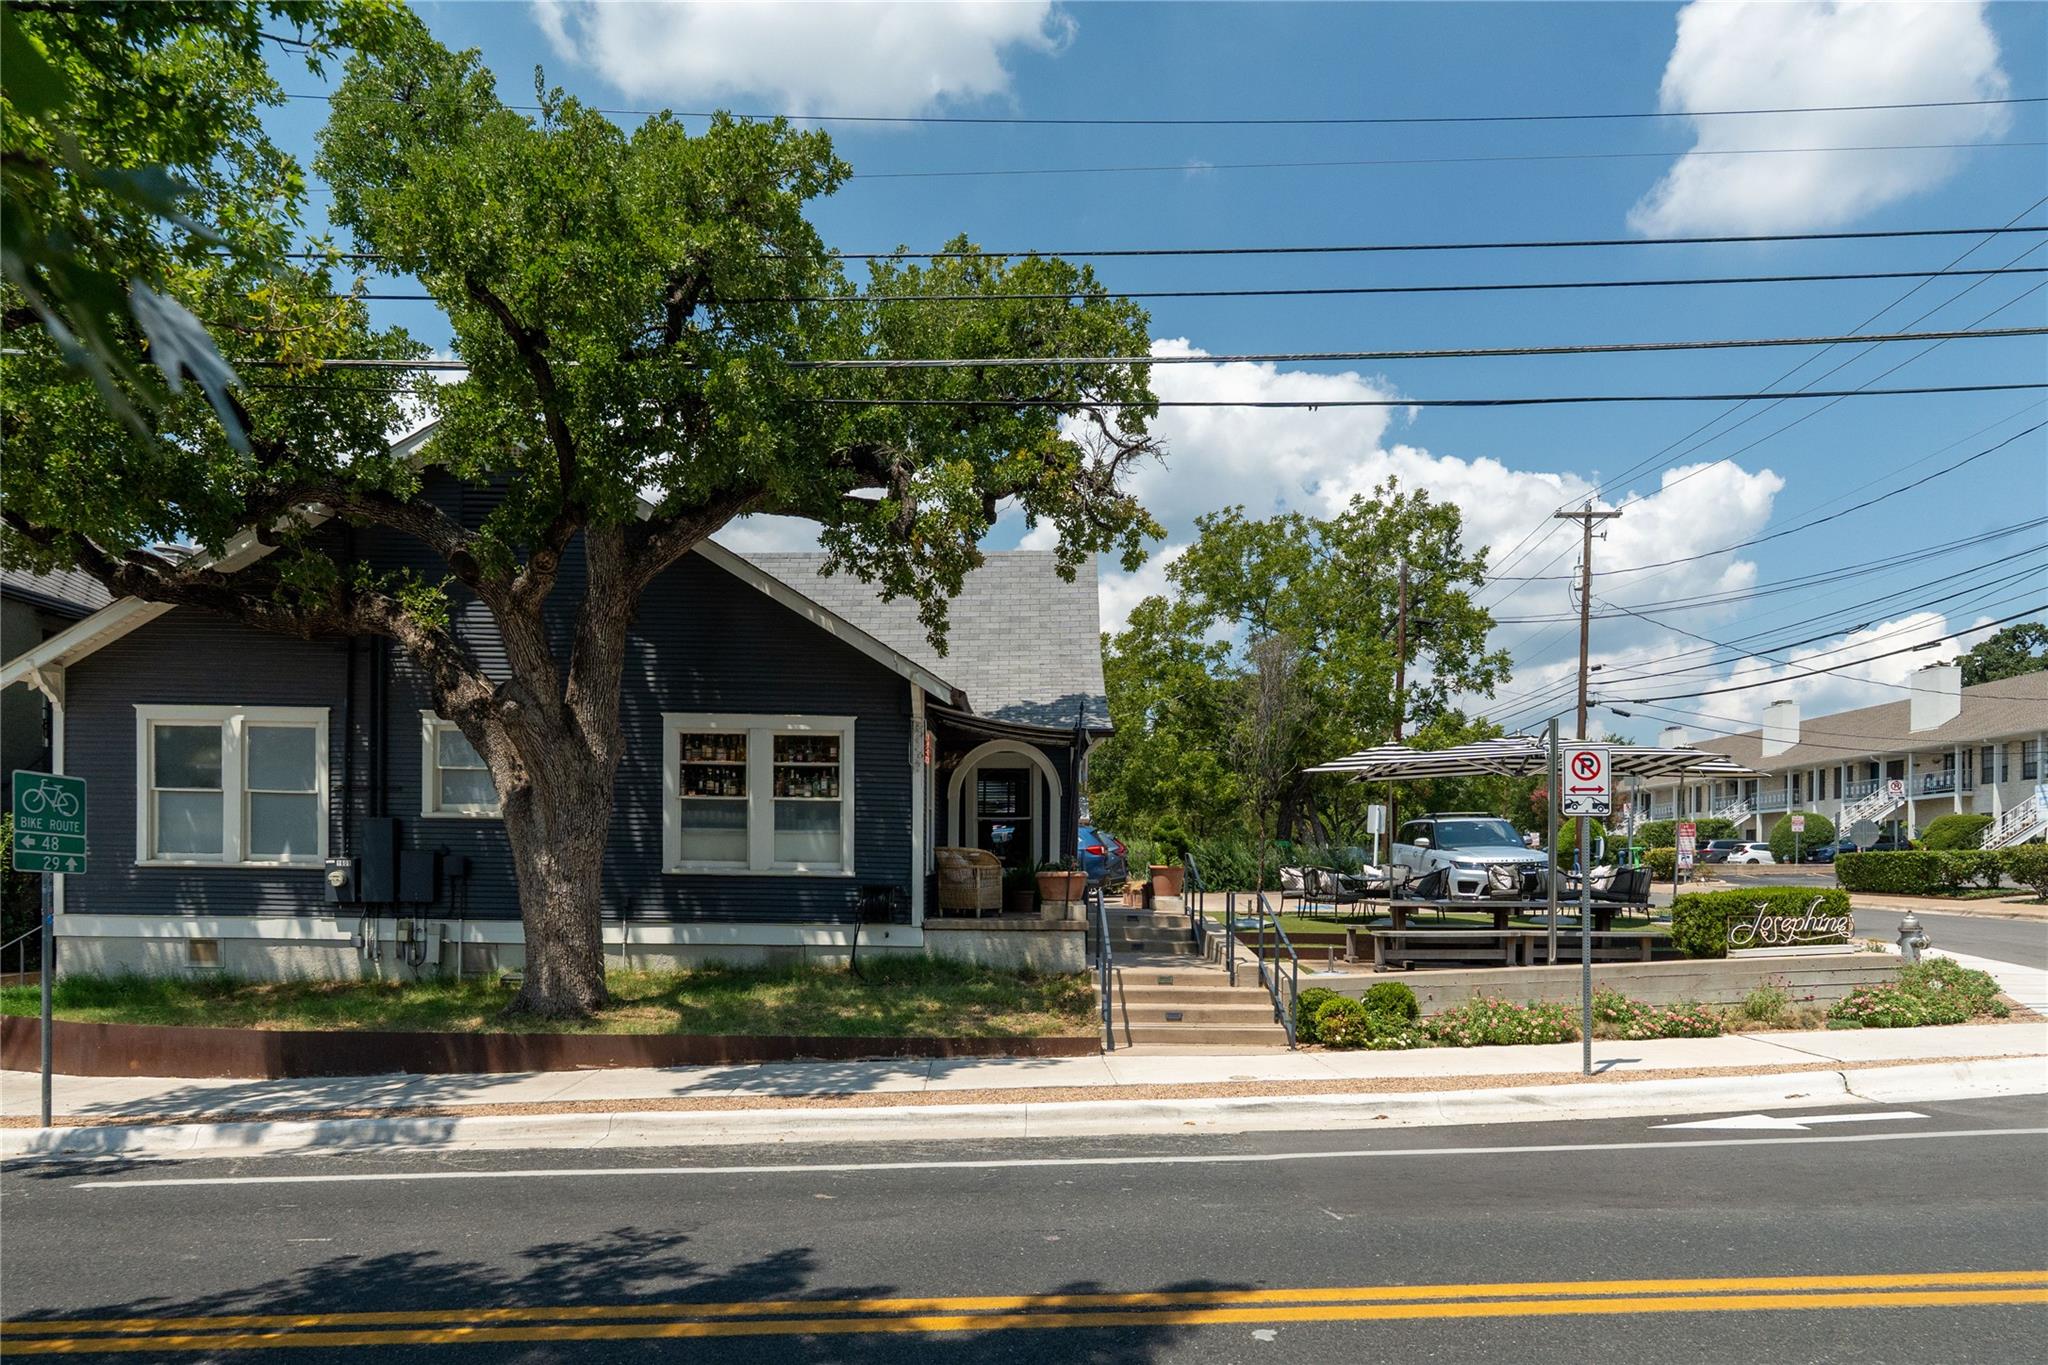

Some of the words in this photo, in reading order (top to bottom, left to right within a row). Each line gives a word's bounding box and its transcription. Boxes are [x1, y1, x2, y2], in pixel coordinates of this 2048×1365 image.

[20, 816, 43, 829] BIKE
[49, 819, 80, 833] ROUTE
[41, 836, 60, 851] 48
[43, 856, 61, 870] 29
[1730, 894, 1852, 945] Josephine
